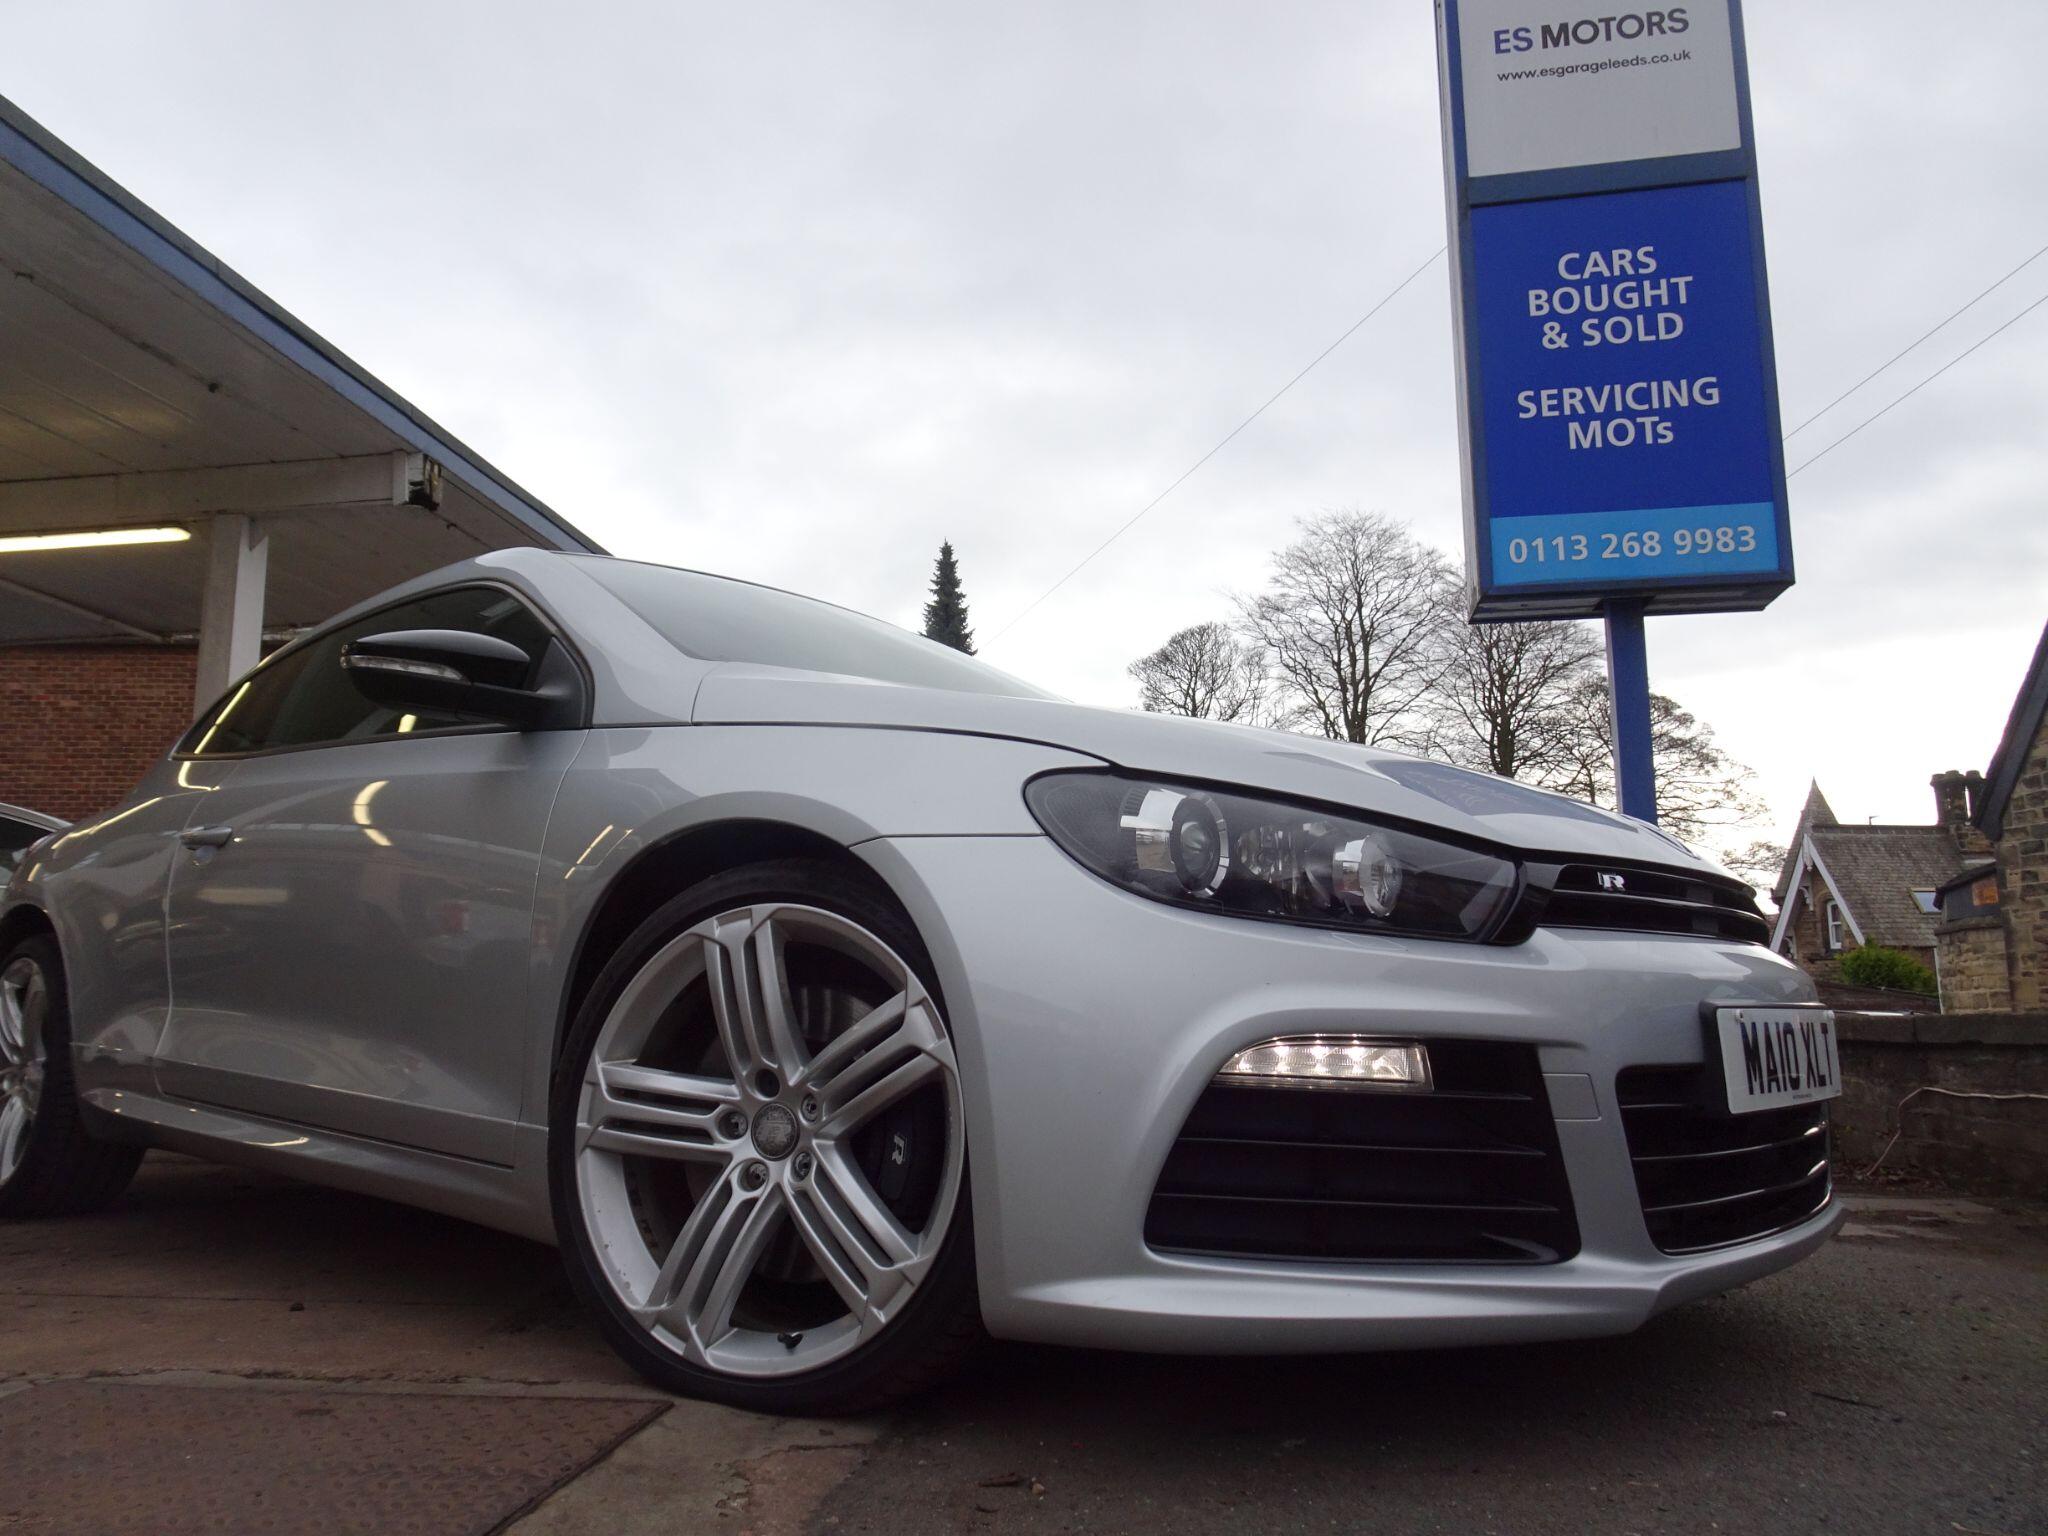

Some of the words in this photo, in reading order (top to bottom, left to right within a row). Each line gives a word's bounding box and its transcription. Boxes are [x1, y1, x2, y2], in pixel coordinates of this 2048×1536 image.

[1494, 26, 1533, 54] ES
[1540, 8, 1690, 49] MOTORS
[1496, 49, 1692, 82] www.esgarageleeds.co.uk
[1557, 246, 1658, 281] CARS
[1527, 275, 1694, 317] BOUGHT
[1541, 321, 1570, 350] &
[1582, 312, 1685, 348] SOLD
[1516, 376, 1720, 419] SERVICING
[1567, 416, 1675, 450] MOTs
[1508, 533, 1589, 564] 0113
[1600, 530, 1662, 559] 268
[1673, 525, 1757, 555] 9983
[1800, 1021, 1833, 1089] XLT
